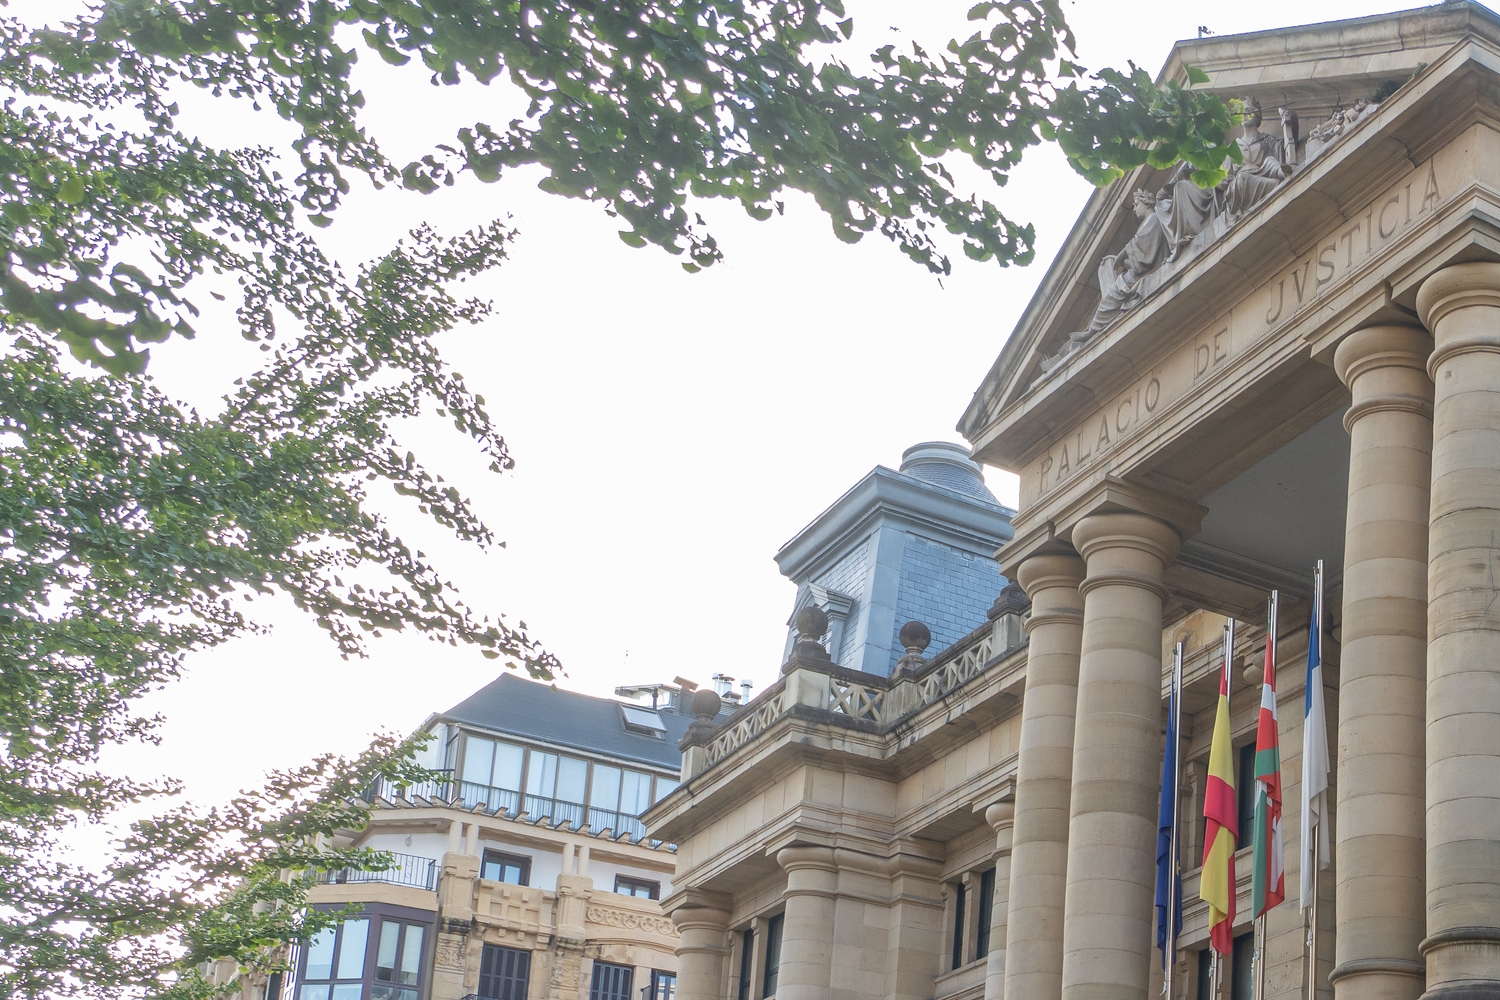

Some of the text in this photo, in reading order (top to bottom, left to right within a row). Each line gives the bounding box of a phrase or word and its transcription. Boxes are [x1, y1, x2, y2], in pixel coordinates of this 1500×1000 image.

[1039, 167, 1442, 494] PALACIO DE JVSTICIA
